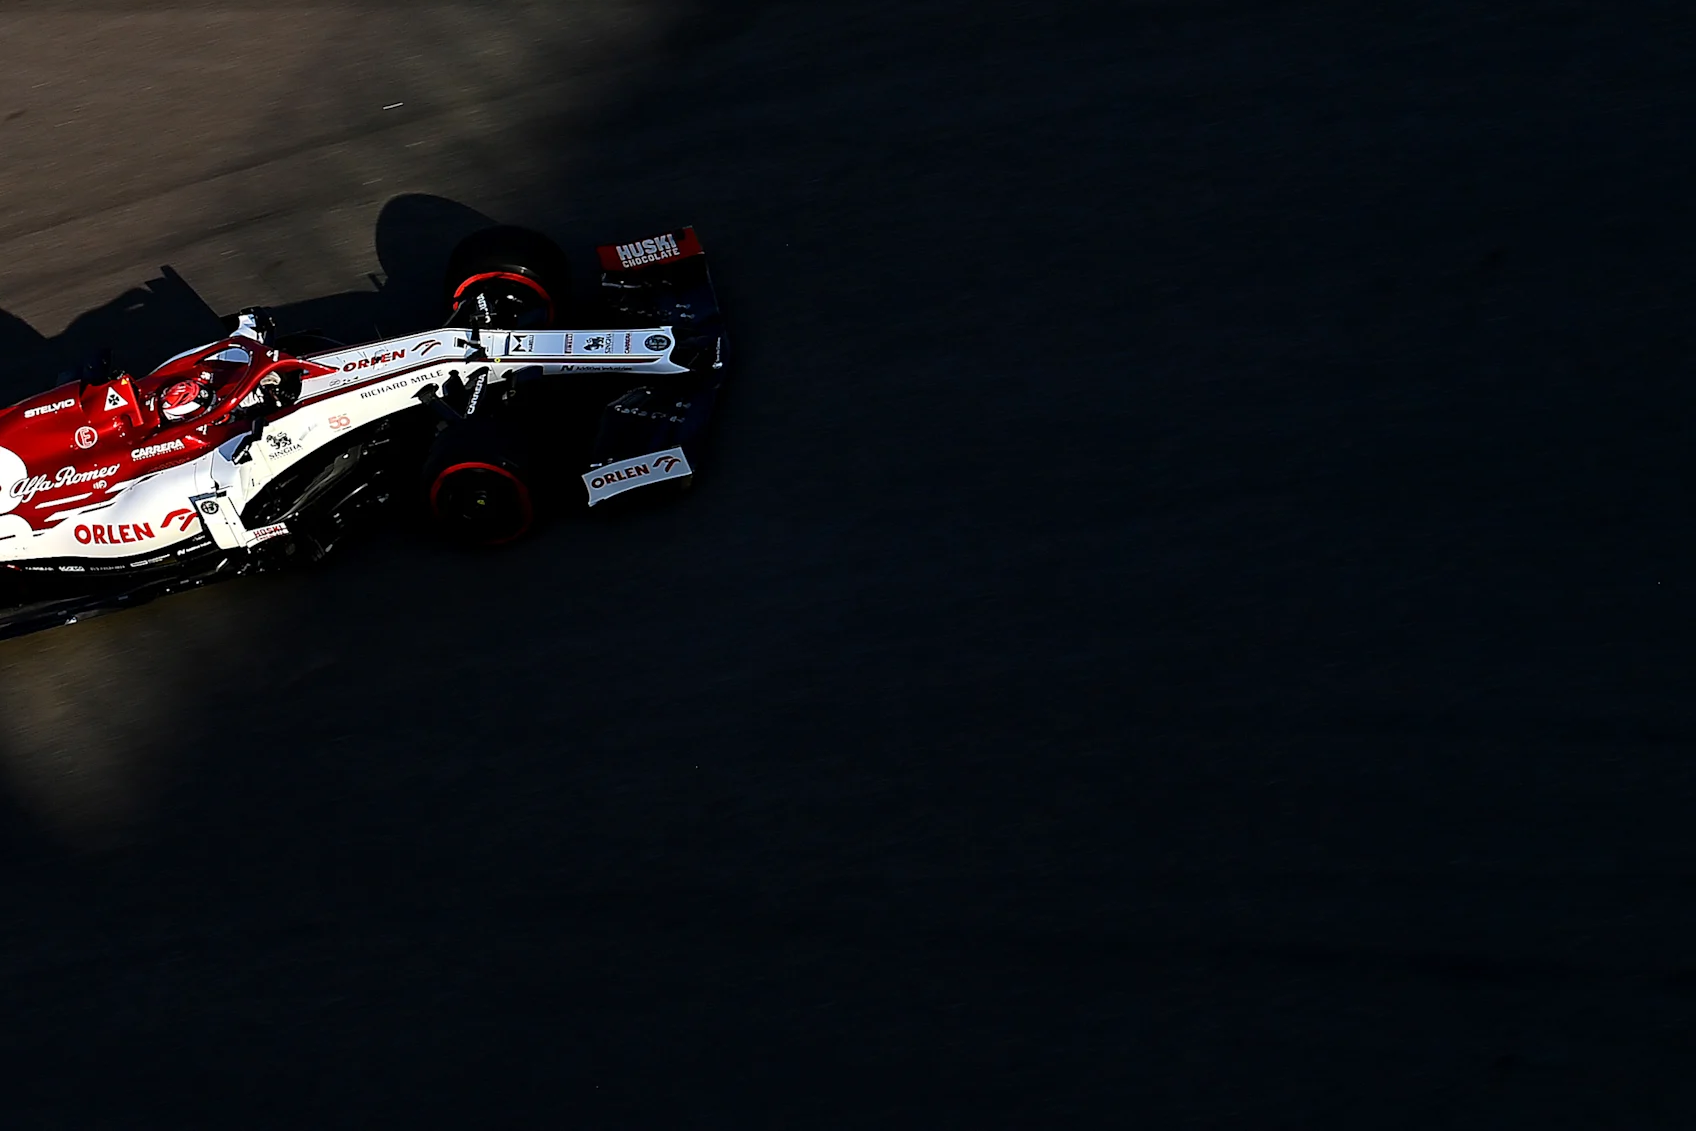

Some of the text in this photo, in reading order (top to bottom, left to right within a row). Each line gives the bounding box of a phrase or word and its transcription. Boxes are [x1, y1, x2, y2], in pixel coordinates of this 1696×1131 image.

[616, 233, 677, 261] HUSKI
[622, 247, 681, 269] CHOCOLATE
[343, 349, 406, 372] ORLEN
[360, 369, 444, 400] RICHARD MILLE
[24, 398, 76, 419] STELVIO
[131, 438, 184, 460] CARRERA
[9, 474, 55, 503] Alfa
[54, 463, 120, 488] Romeo
[591, 464, 651, 489] ORLEN
[74, 523, 155, 545] ORLEN
